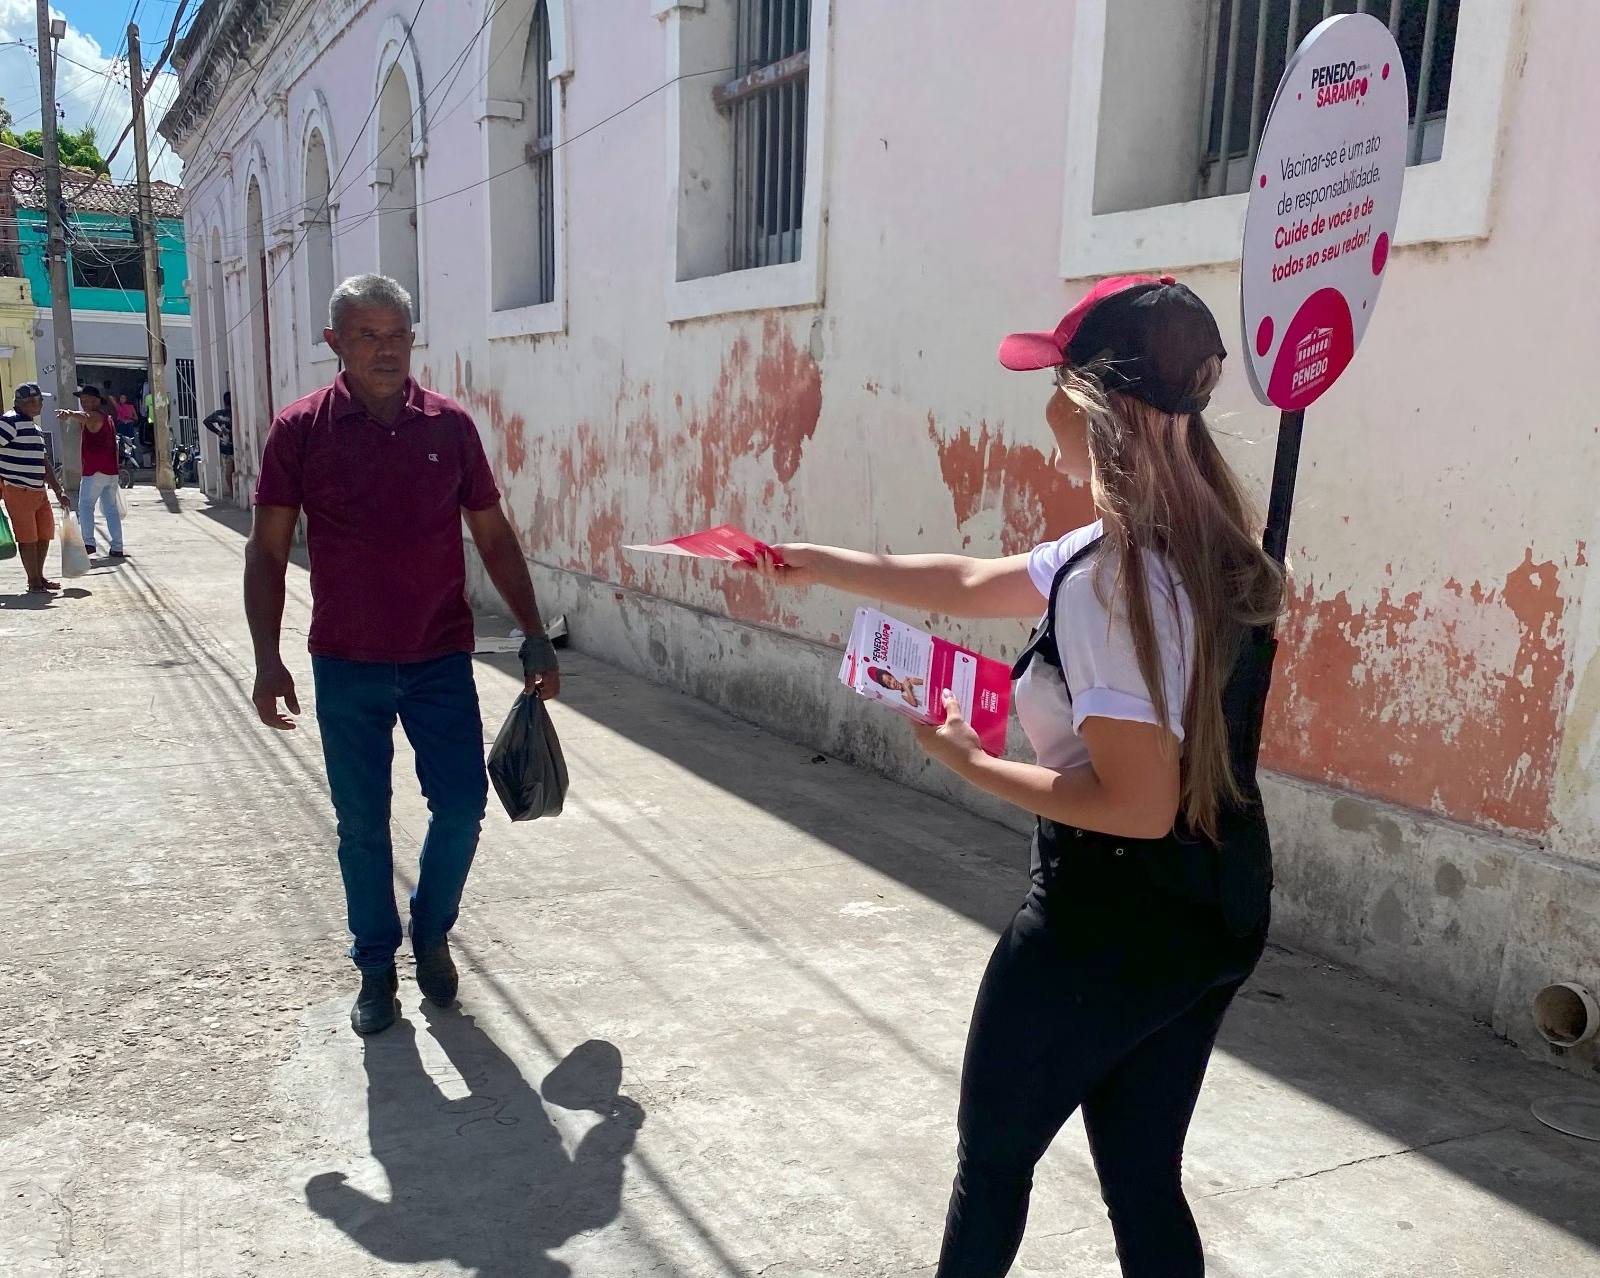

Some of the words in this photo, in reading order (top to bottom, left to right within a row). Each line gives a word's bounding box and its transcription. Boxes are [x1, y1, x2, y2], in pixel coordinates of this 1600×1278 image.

[1311, 61, 1356, 89] PENEDO
[1280, 153, 1338, 181] Vacinar-se
[1339, 141, 1347, 164] é
[1348, 142, 1364, 161] um
[1365, 135, 1381, 155] ato
[1277, 192, 1293, 216] de
[1295, 162, 1381, 213] responsabilidade.
[1275, 219, 1309, 249] Cuide
[1311, 213, 1326, 237] de
[1328, 202, 1353, 230] você
[1353, 205, 1360, 220] e
[1361, 195, 1374, 217] de
[1272, 255, 1304, 283] todos
[1306, 252, 1320, 270] ao
[1321, 244, 1341, 264] seu
[1342, 224, 1371, 255] redor!
[1292, 357, 1329, 391] PENEDO
[872, 632, 882, 663] PENEDO
